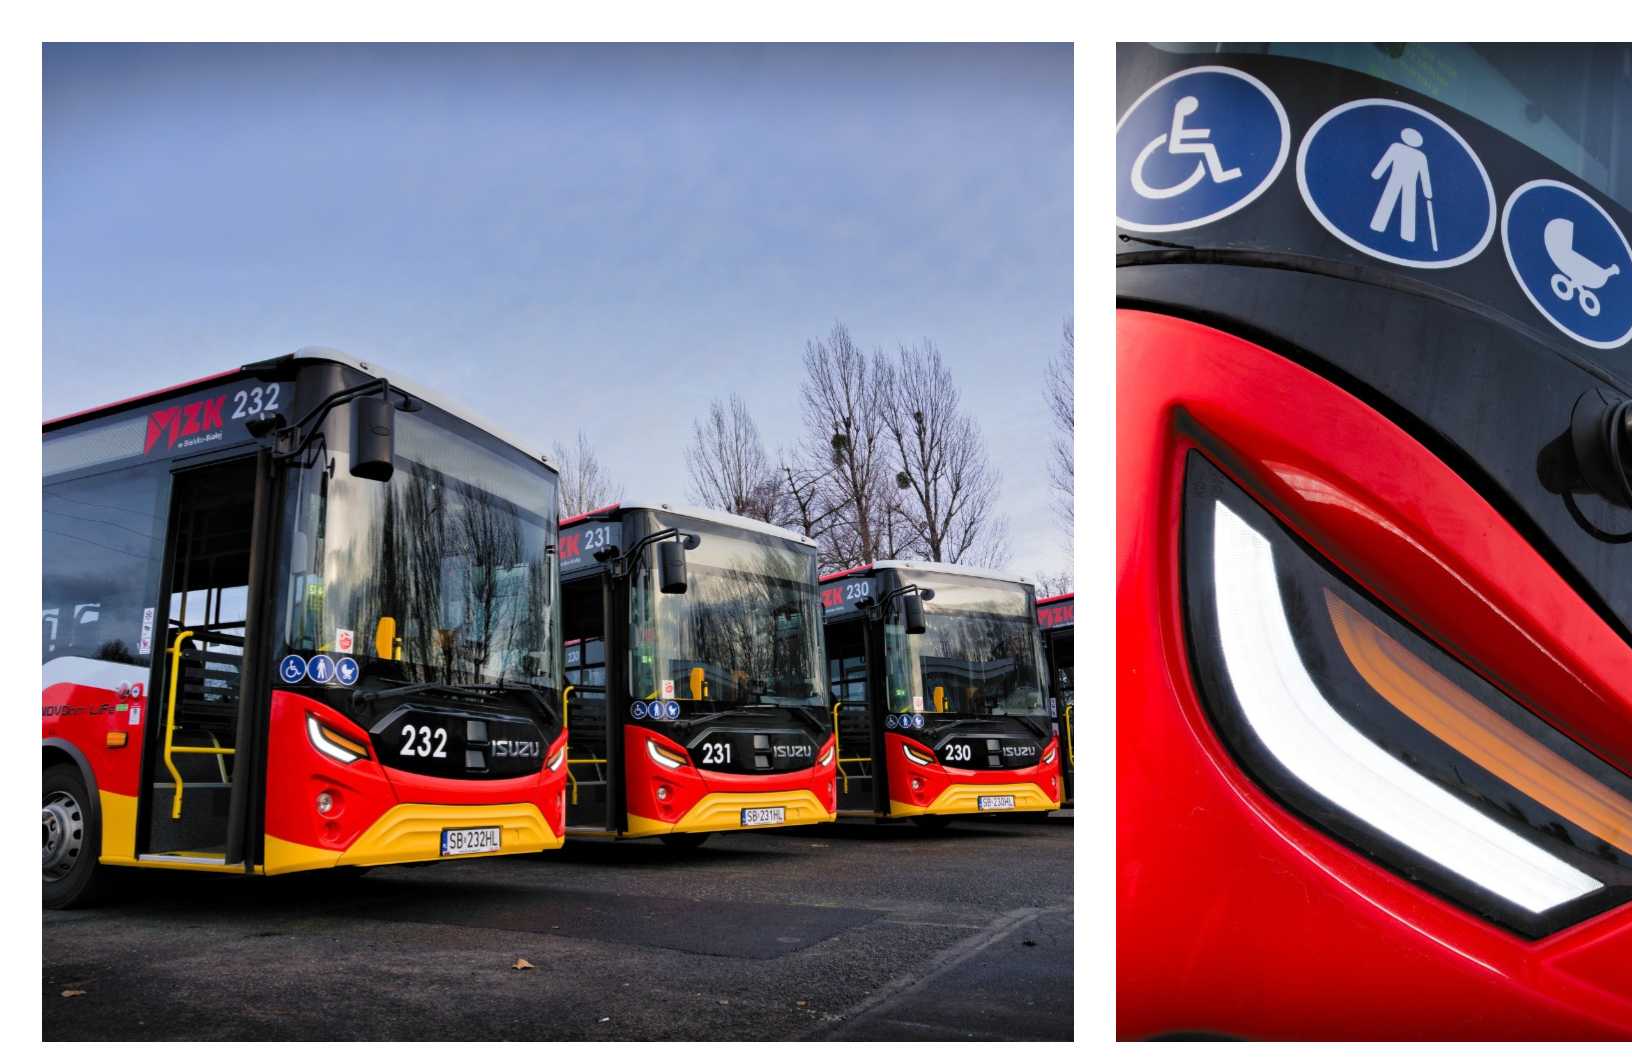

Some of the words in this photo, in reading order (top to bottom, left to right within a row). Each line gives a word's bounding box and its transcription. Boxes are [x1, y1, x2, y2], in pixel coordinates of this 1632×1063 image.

[231, 382, 280, 419] 232
[144, 394, 228, 456] MZK
[559, 532, 580, 560] ZK
[584, 526, 611, 550] 231
[847, 581, 869, 600] 230
[400, 724, 447, 758] 232
[491, 739, 540, 757] ISUZU
[773, 745, 812, 758] ISUZU
[1002, 746, 1036, 757] ISUZU
[702, 742, 731, 764] 231
[945, 744, 971, 761] 230
